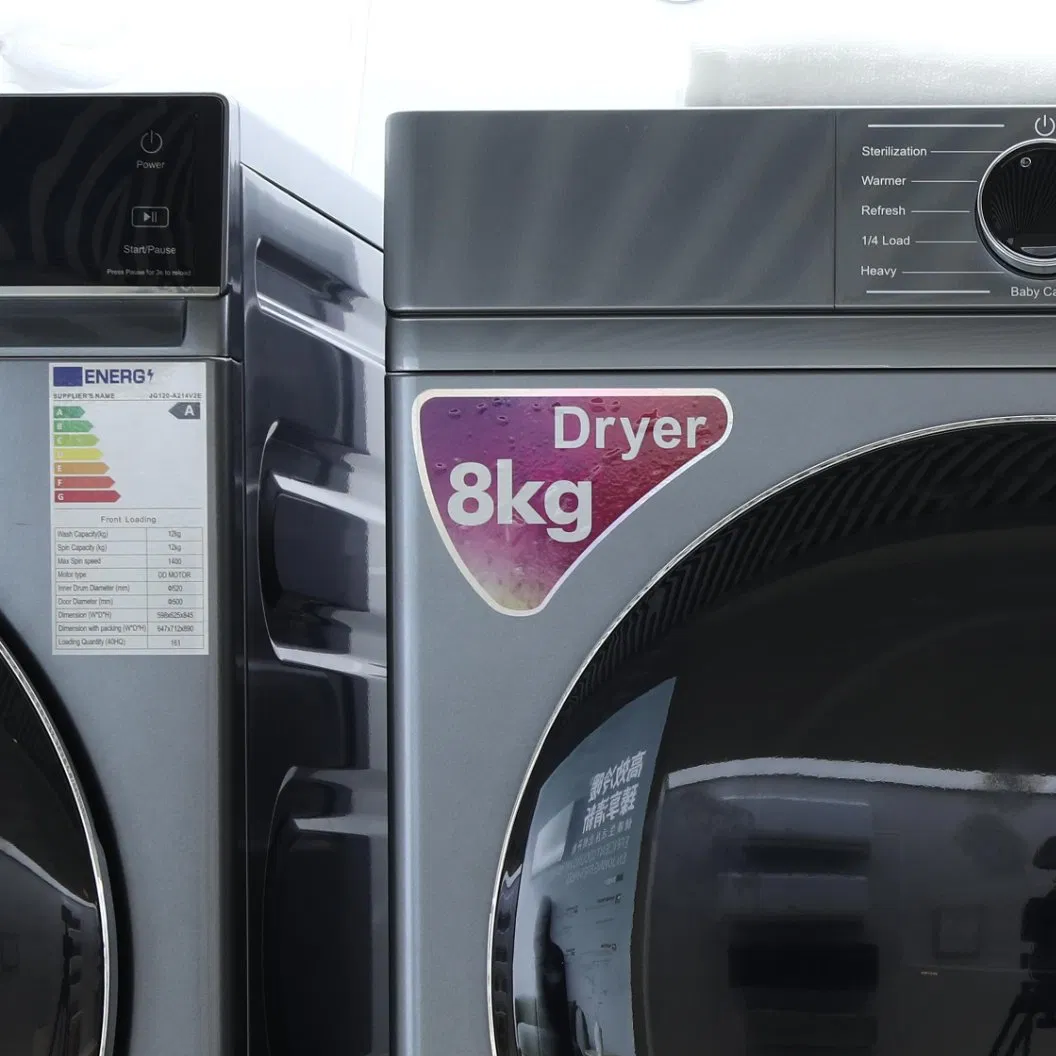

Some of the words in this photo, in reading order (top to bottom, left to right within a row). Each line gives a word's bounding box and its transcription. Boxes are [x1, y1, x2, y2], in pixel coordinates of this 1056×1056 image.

[861, 146, 927, 157] Sterilization
[136, 160, 165, 169] Power
[861, 176, 906, 186] Warmer
[861, 205, 906, 216] Refresh
[862, 235, 879, 246] 1/4
[882, 235, 910, 246] Load
[123, 244, 176, 254] Start/Pause
[861, 266, 897, 278] Heavy
[1010, 286, 1040, 299] Baby
[85, 369, 145, 384] ENERG
[56, 408, 63, 416] A
[184, 405, 195, 416] A
[554, 406, 707, 461] Dryer
[447, 459, 593, 543] 8kg
[125, 516, 157, 524] Loading
[57, 544, 70, 552] Spin
[71, 544, 95, 552] Capacity
[96, 544, 107, 552] (kg)
[58, 638, 80, 646] Loading
[81, 638, 104, 646] Quantity
